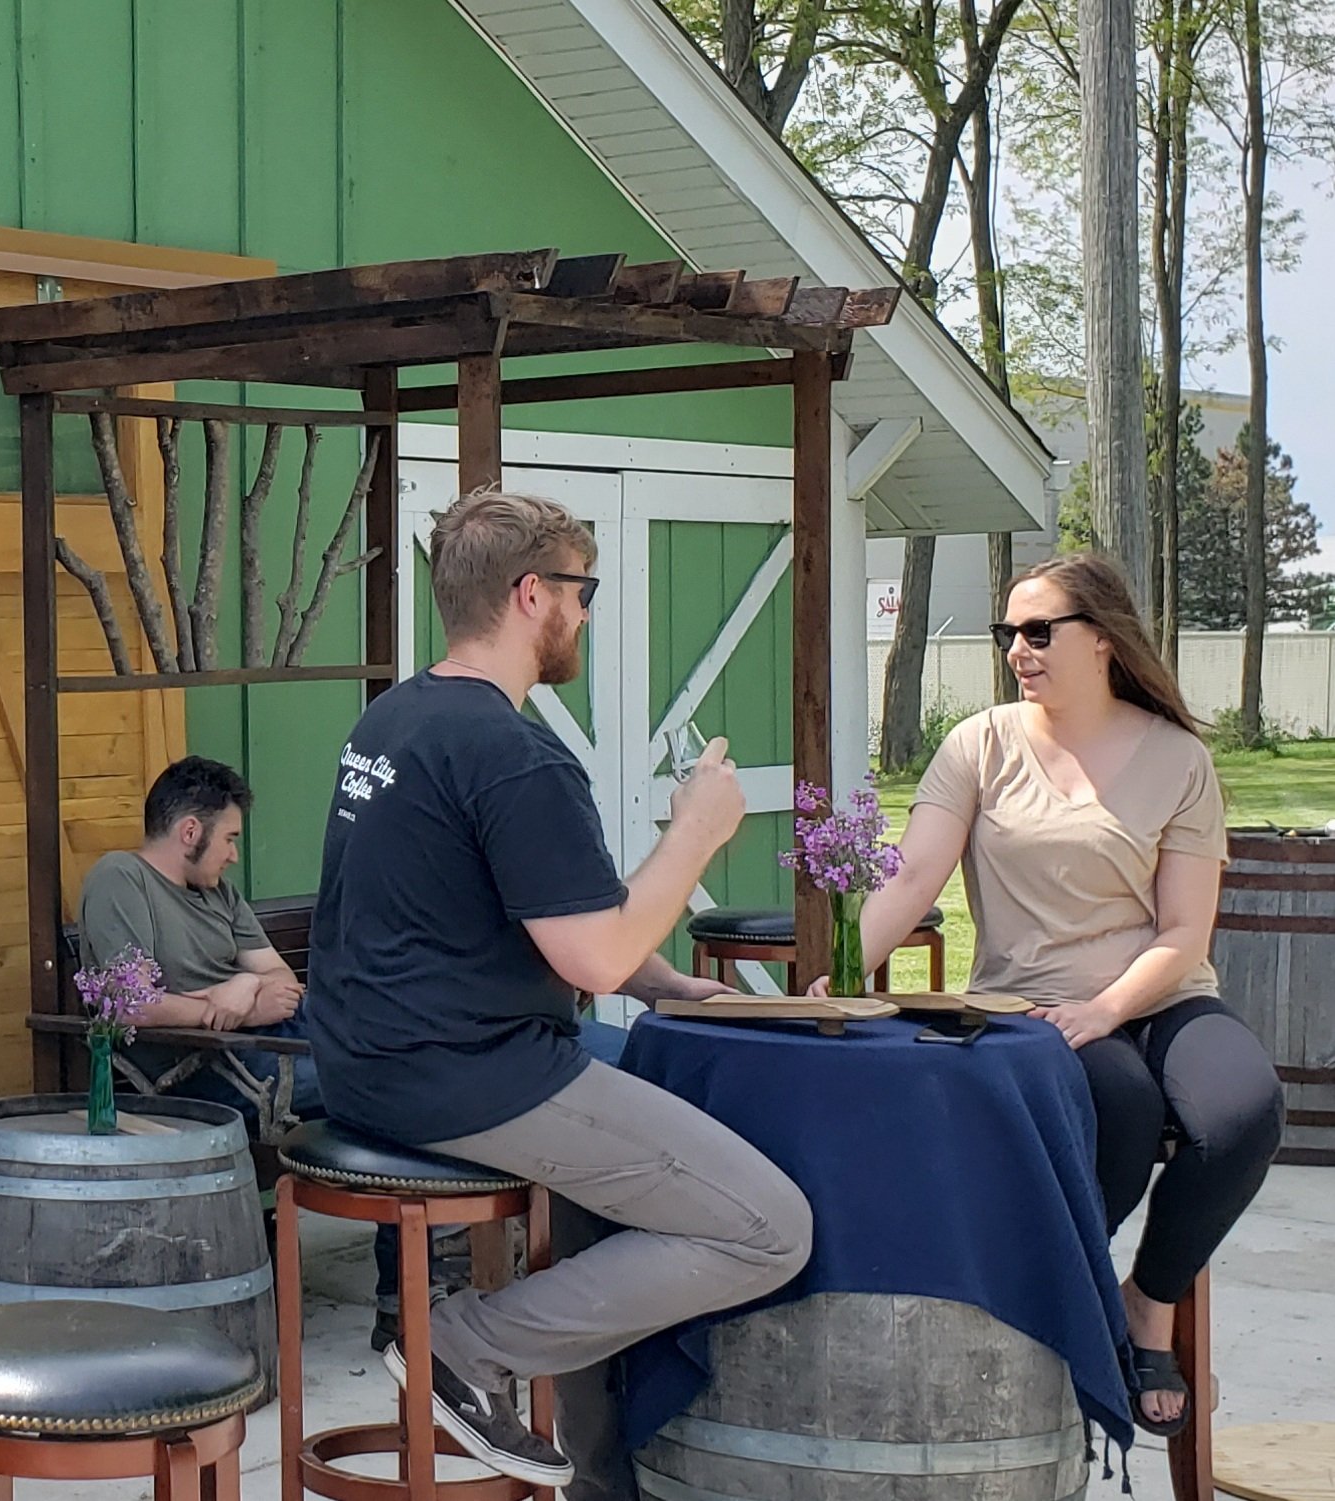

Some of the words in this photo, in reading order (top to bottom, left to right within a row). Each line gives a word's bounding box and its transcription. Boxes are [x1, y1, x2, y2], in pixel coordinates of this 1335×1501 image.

[341, 742, 372, 773] Queen
[371, 755, 396, 788] City
[341, 770, 373, 800] Coffee
